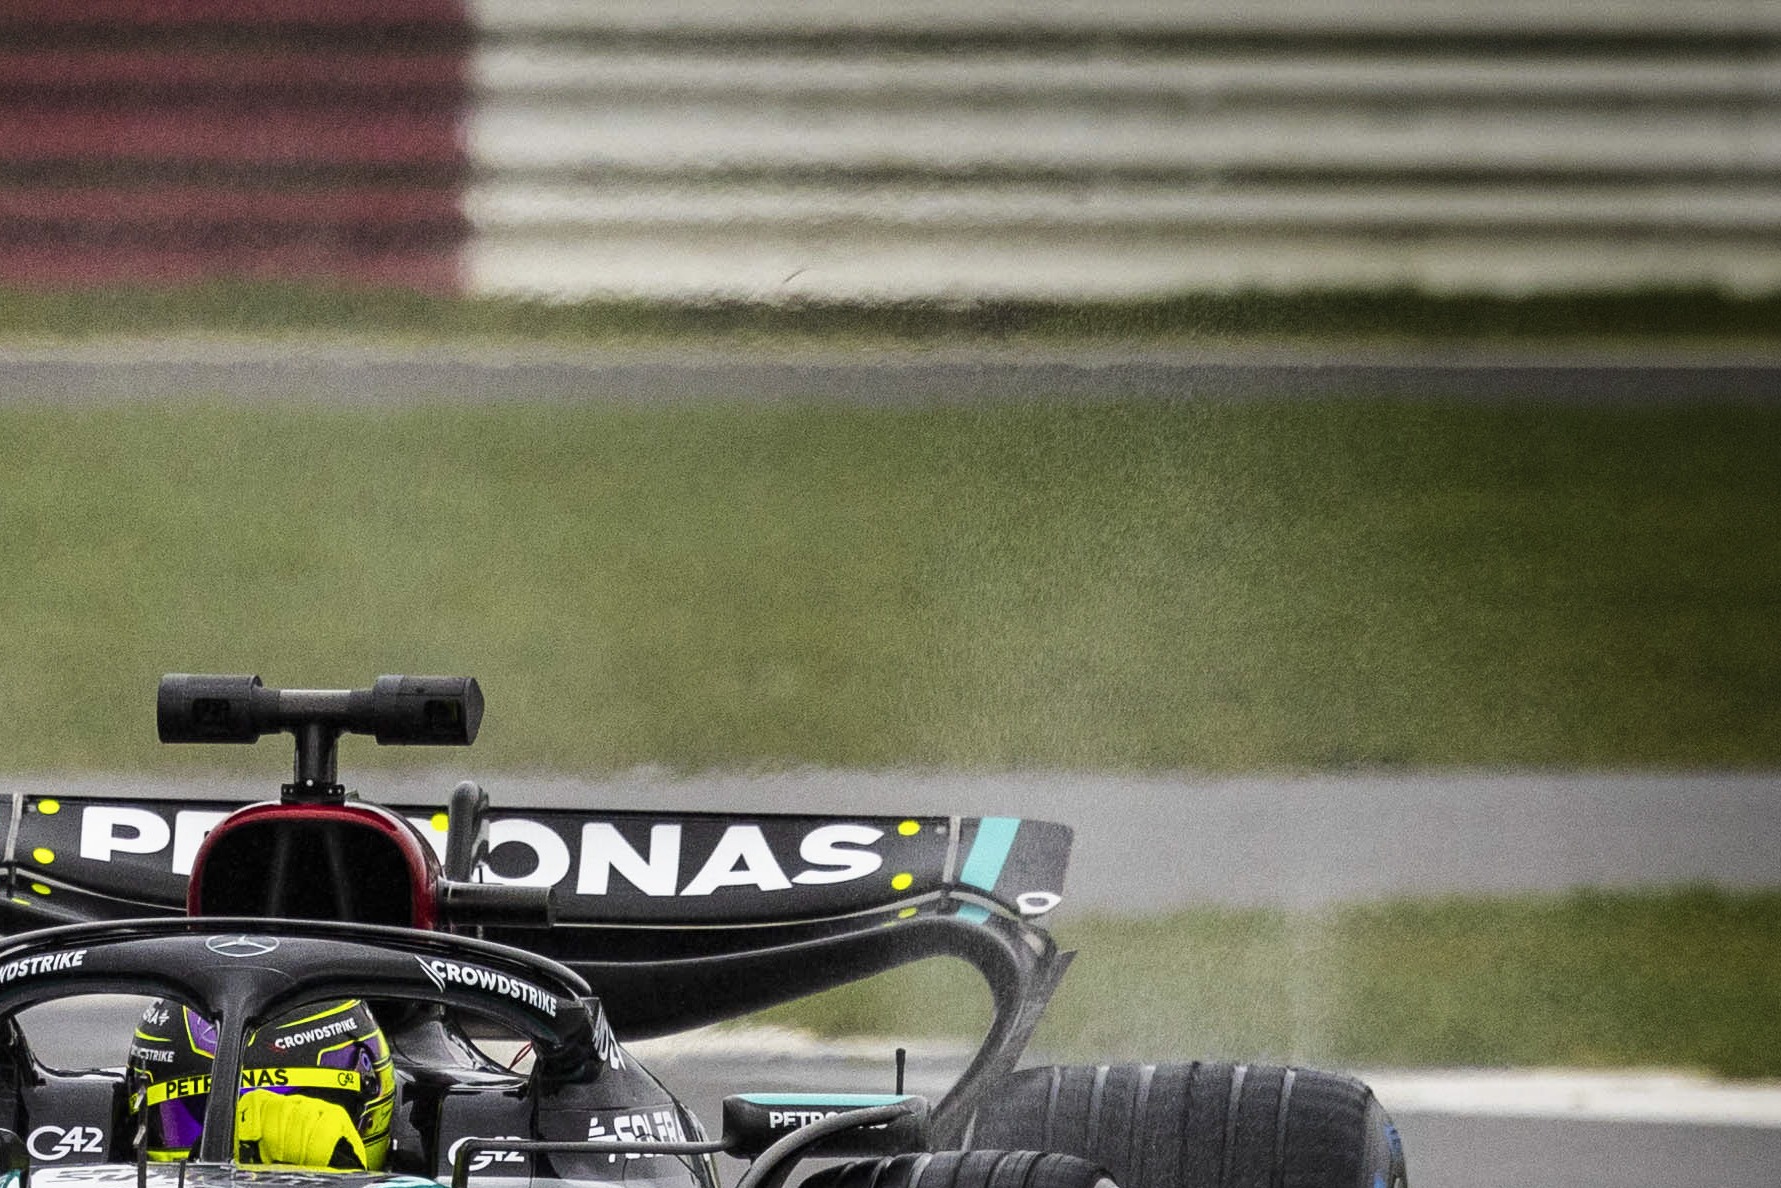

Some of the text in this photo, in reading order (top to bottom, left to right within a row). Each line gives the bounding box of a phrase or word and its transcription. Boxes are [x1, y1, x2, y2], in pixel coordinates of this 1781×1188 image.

[430, 960, 558, 1018] CROWDSTRIKE
[274, 1017, 358, 1050] CROWDSTRIKE
[26, 1125, 104, 1161] G42
